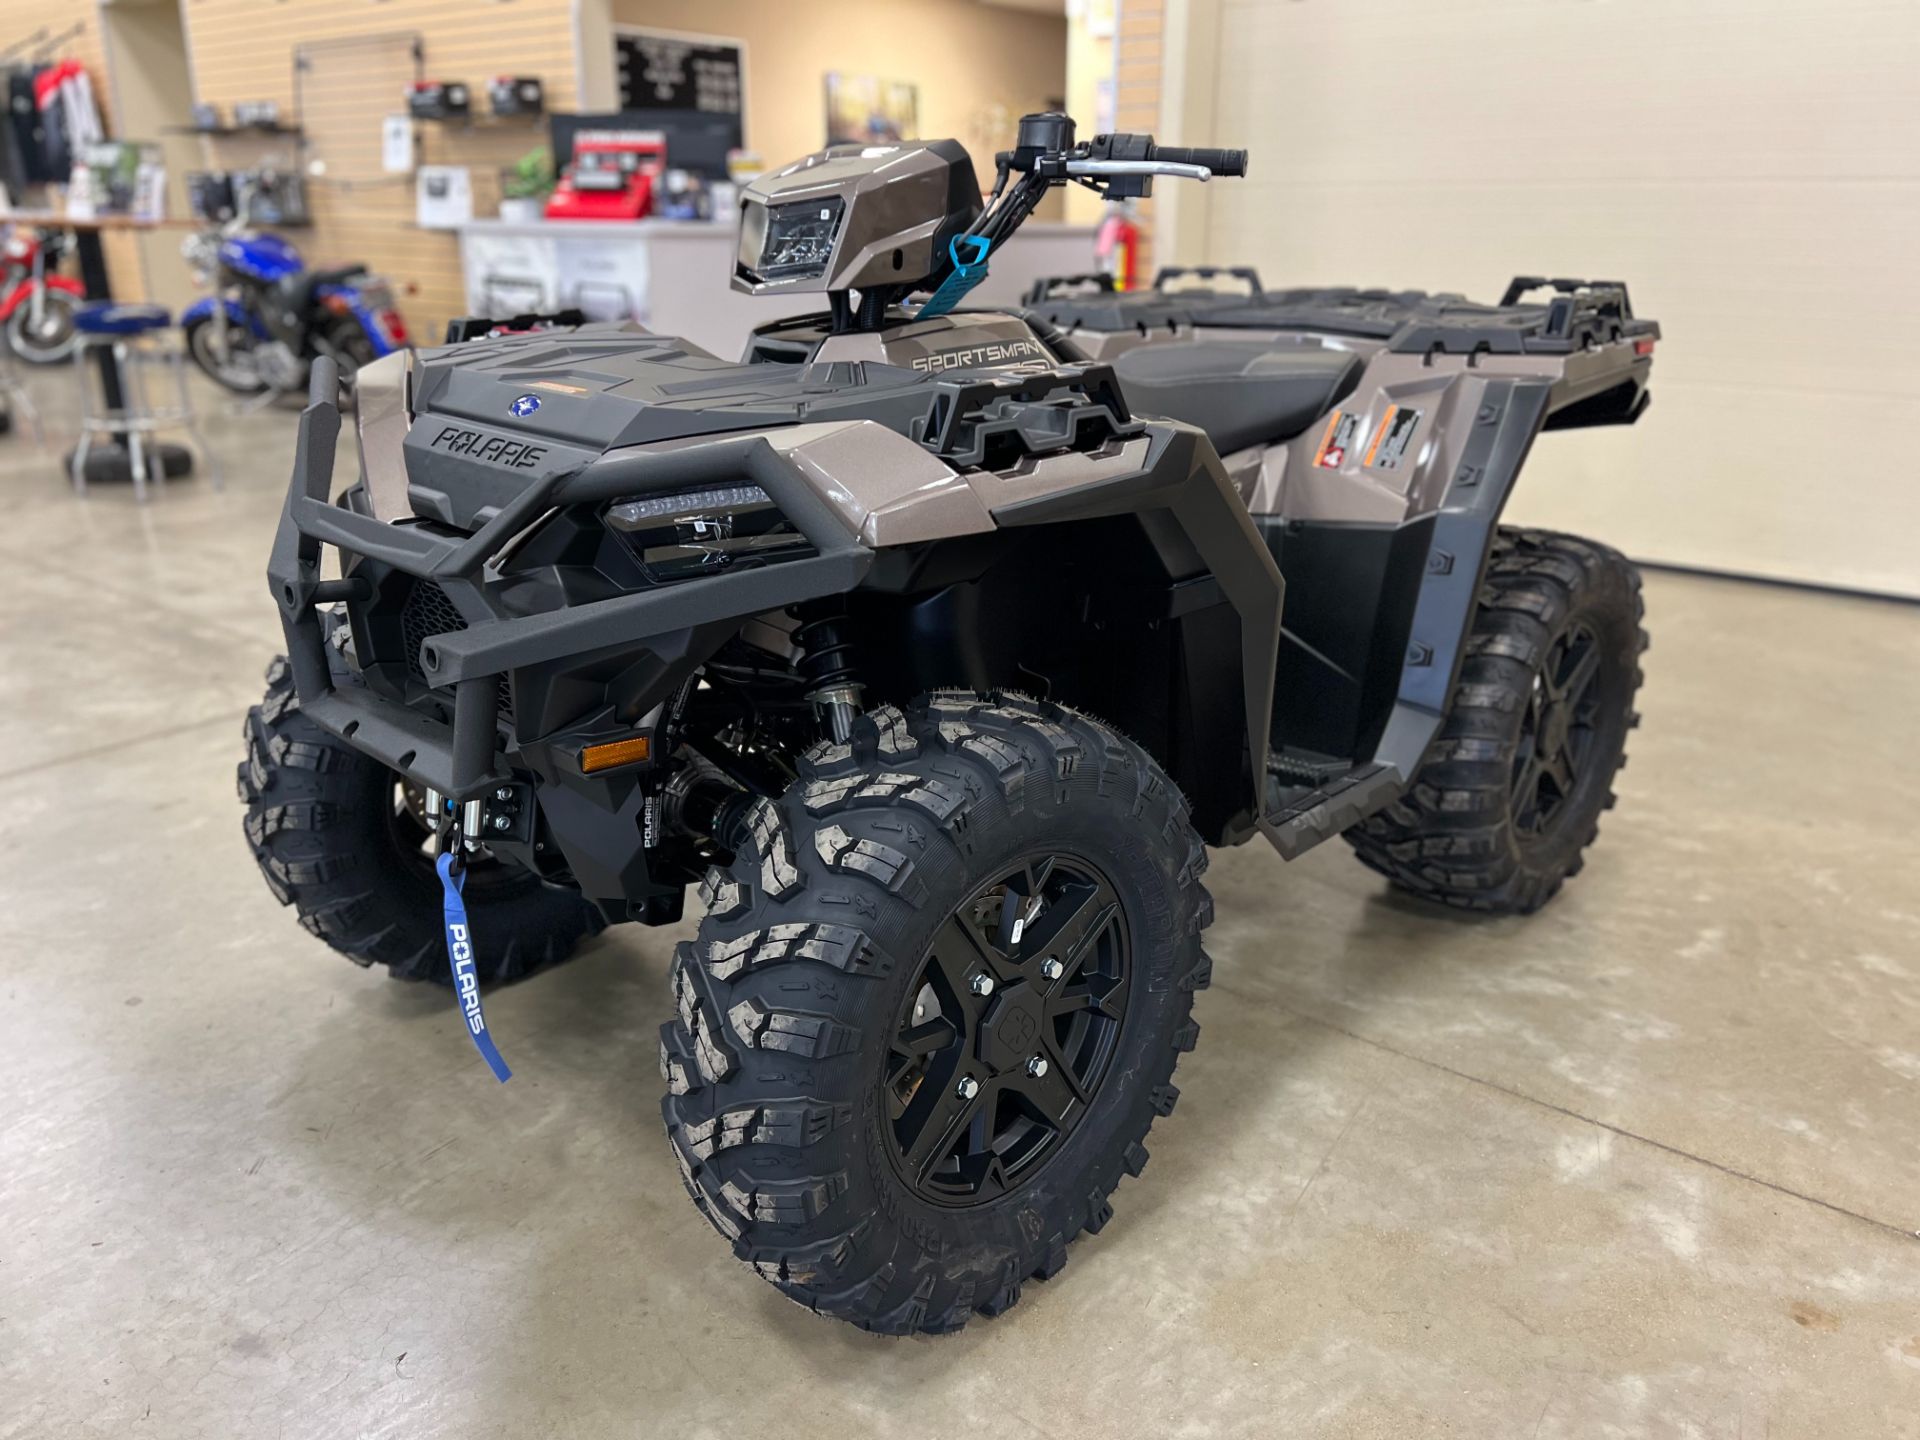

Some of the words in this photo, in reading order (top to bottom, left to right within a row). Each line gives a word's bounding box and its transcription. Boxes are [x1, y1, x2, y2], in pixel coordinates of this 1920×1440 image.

[911, 341, 1041, 373] SPORTSMAN
[431, 427, 548, 468] POLARIS
[644, 796, 653, 848] POLARIS
[449, 923, 485, 1035] POLARIS
